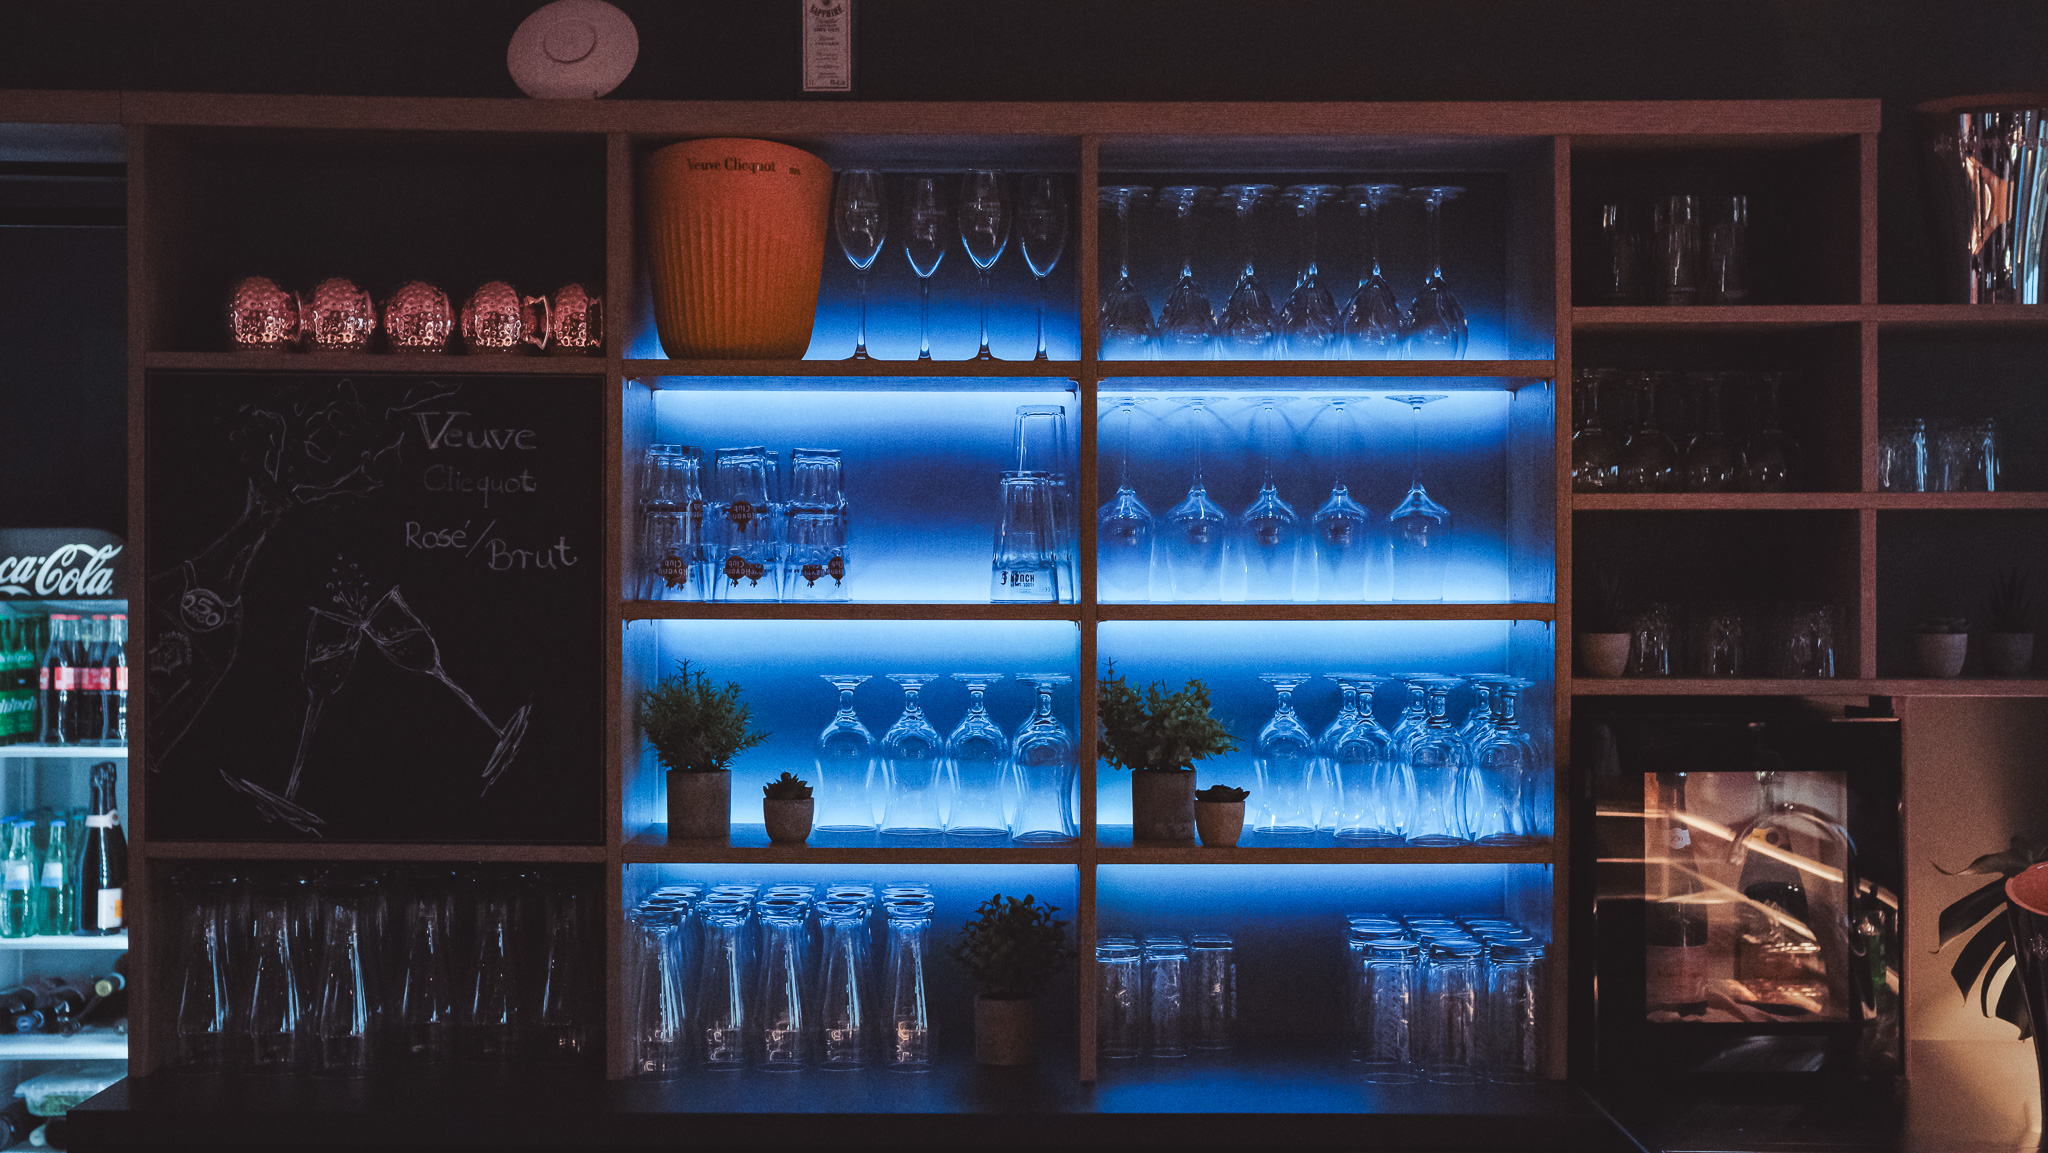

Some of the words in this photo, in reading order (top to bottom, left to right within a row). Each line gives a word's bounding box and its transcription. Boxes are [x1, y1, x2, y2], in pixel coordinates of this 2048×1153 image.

[686, 157, 721, 171] Veuve
[724, 157, 776, 175] Clicquot
[411, 411, 538, 450] Veuve
[423, 464, 537, 509] Clicquot
[733, 505, 751, 513] Club
[0, 543, 124, 597] ca-Cola
[664, 560, 682, 568] Club
[728, 560, 745, 568] Club
